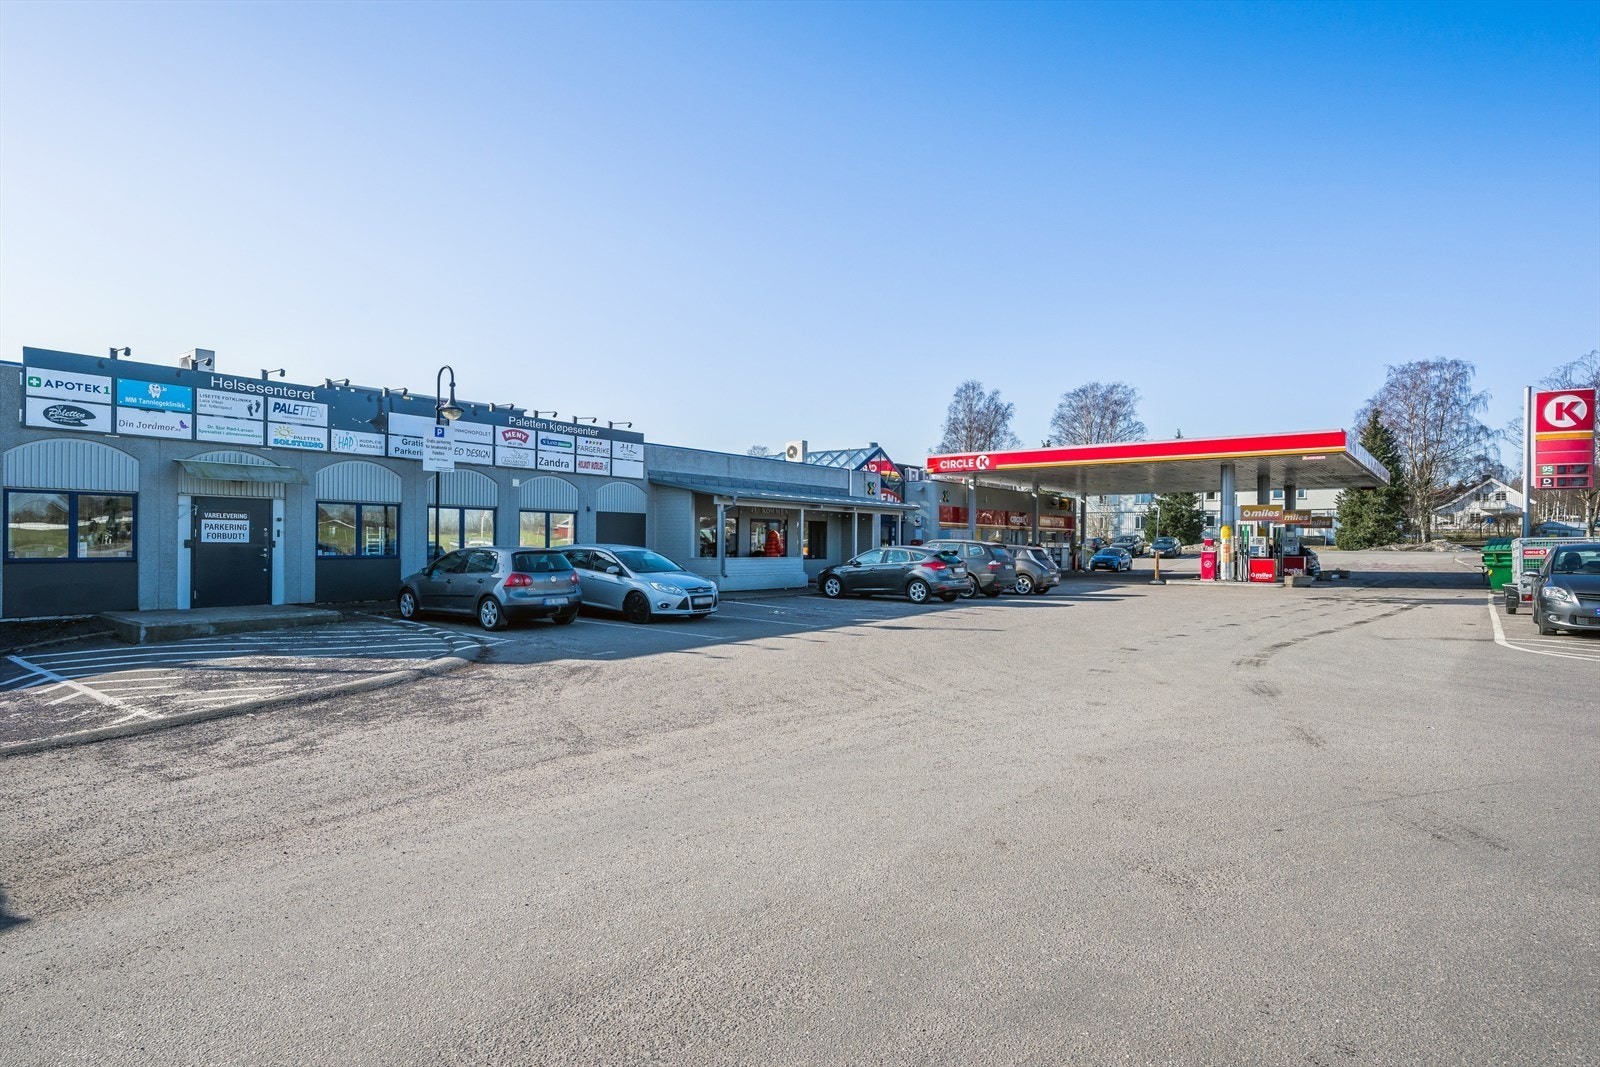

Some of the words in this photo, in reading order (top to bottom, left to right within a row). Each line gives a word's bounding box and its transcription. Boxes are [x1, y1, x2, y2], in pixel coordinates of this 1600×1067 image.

[44, 379, 101, 394] APOTEK
[103, 386, 110, 394] 1
[210, 375, 316, 400] Helsesenteret
[125, 396, 137, 404] MM
[138, 397, 185, 409] Tannlegeklinikk
[48, 407, 86, 419] Paletten
[272, 401, 324, 418] PALETTEN
[1552, 400, 1584, 425] K
[118, 419, 134, 428] Din
[508, 416, 547, 430] Paletten
[549, 423, 599, 437] kjøpesenter
[293, 434, 321, 442] PALETTEN
[505, 432, 527, 440] MENY
[273, 438, 324, 449] SOLSTUDIO
[401, 438, 423, 447] Gratis
[394, 447, 423, 456] Parkeri
[466, 448, 491, 459] DESIGN
[577, 445, 610, 455] FARGERIKE
[539, 457, 570, 469] Zandra
[940, 459, 974, 469] CIRCLE
[977, 456, 989, 469] K
[1251, 509, 1280, 517] miles
[204, 523, 248, 531] PARKERING
[206, 532, 245, 540] FORBUDT!
